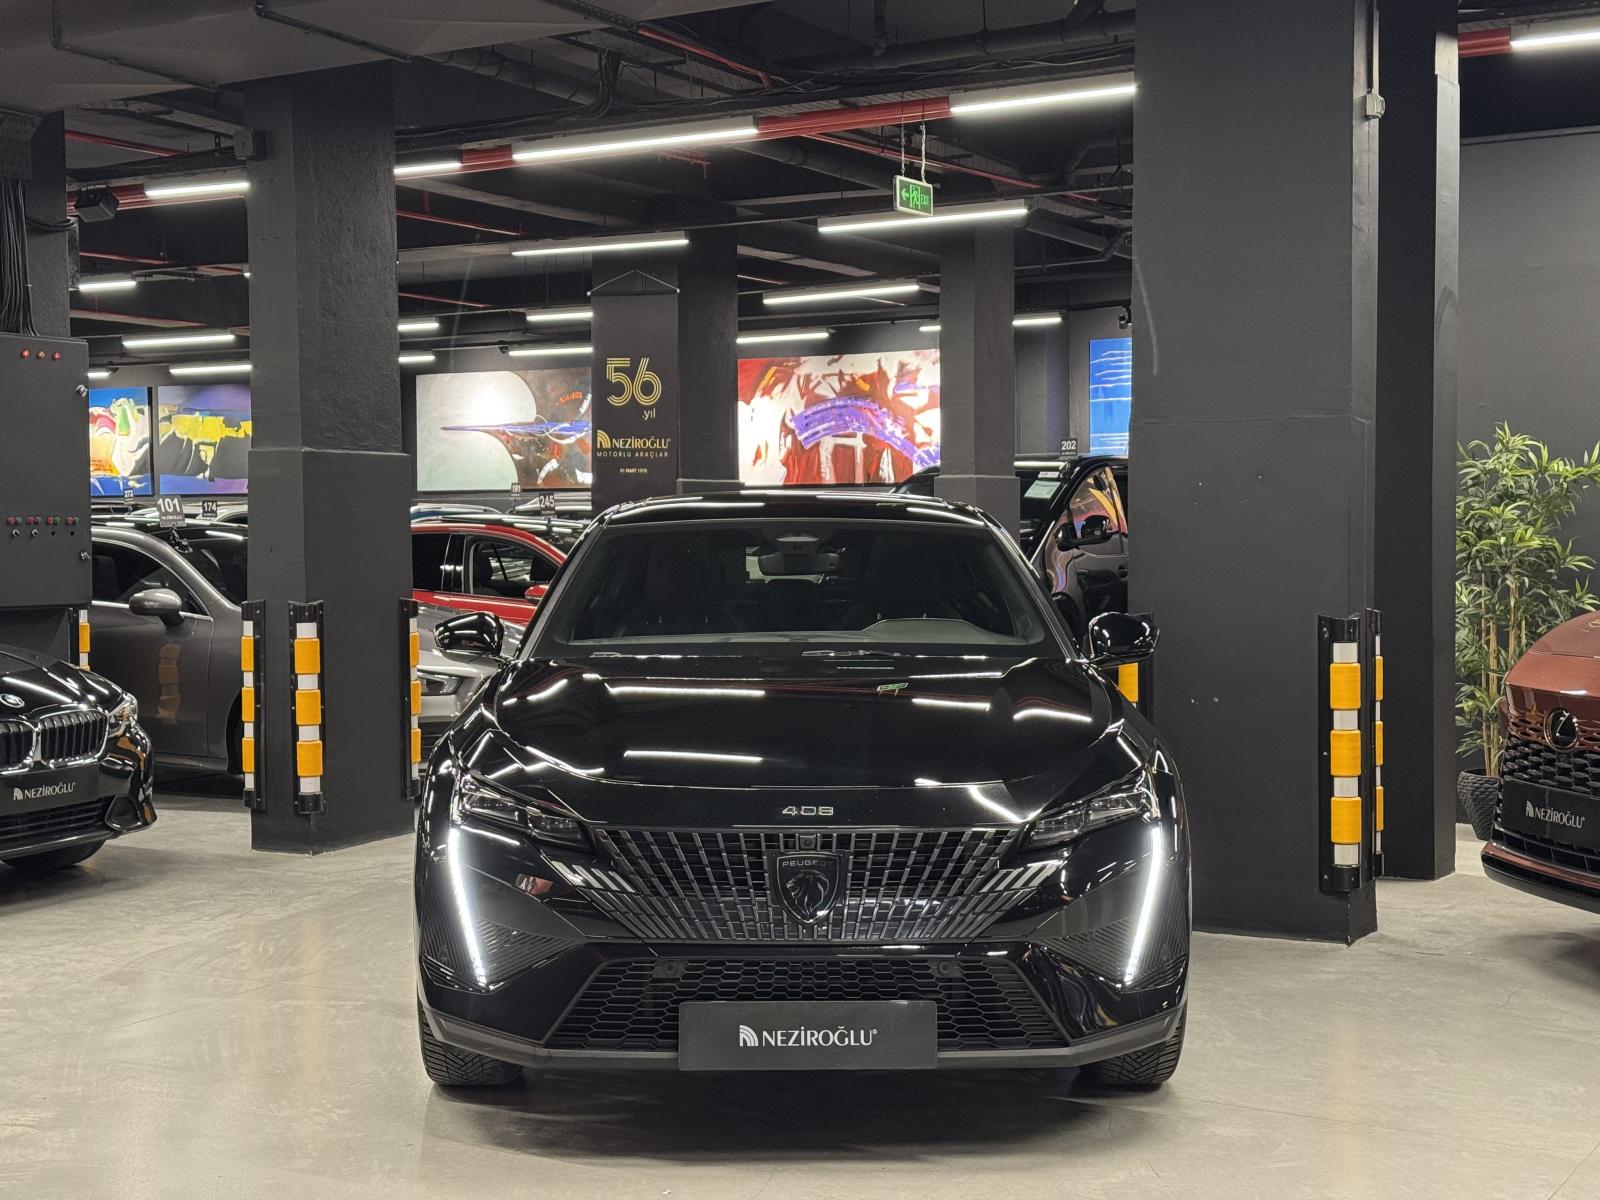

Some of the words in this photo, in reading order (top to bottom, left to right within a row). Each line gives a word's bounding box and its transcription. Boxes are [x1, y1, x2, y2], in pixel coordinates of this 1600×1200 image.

[606, 357, 662, 406] 56
[612, 436, 669, 449] NEZİROĞLU
[1061, 440, 1077, 451] 202
[158, 498, 181, 512] 101
[203, 502, 216, 511] 174
[540, 495, 555, 508] 245
[24, 781, 75, 799] NEZİROĞLU
[782, 806, 834, 816] 408
[762, 1026, 873, 1047] NEZİROĞLU
